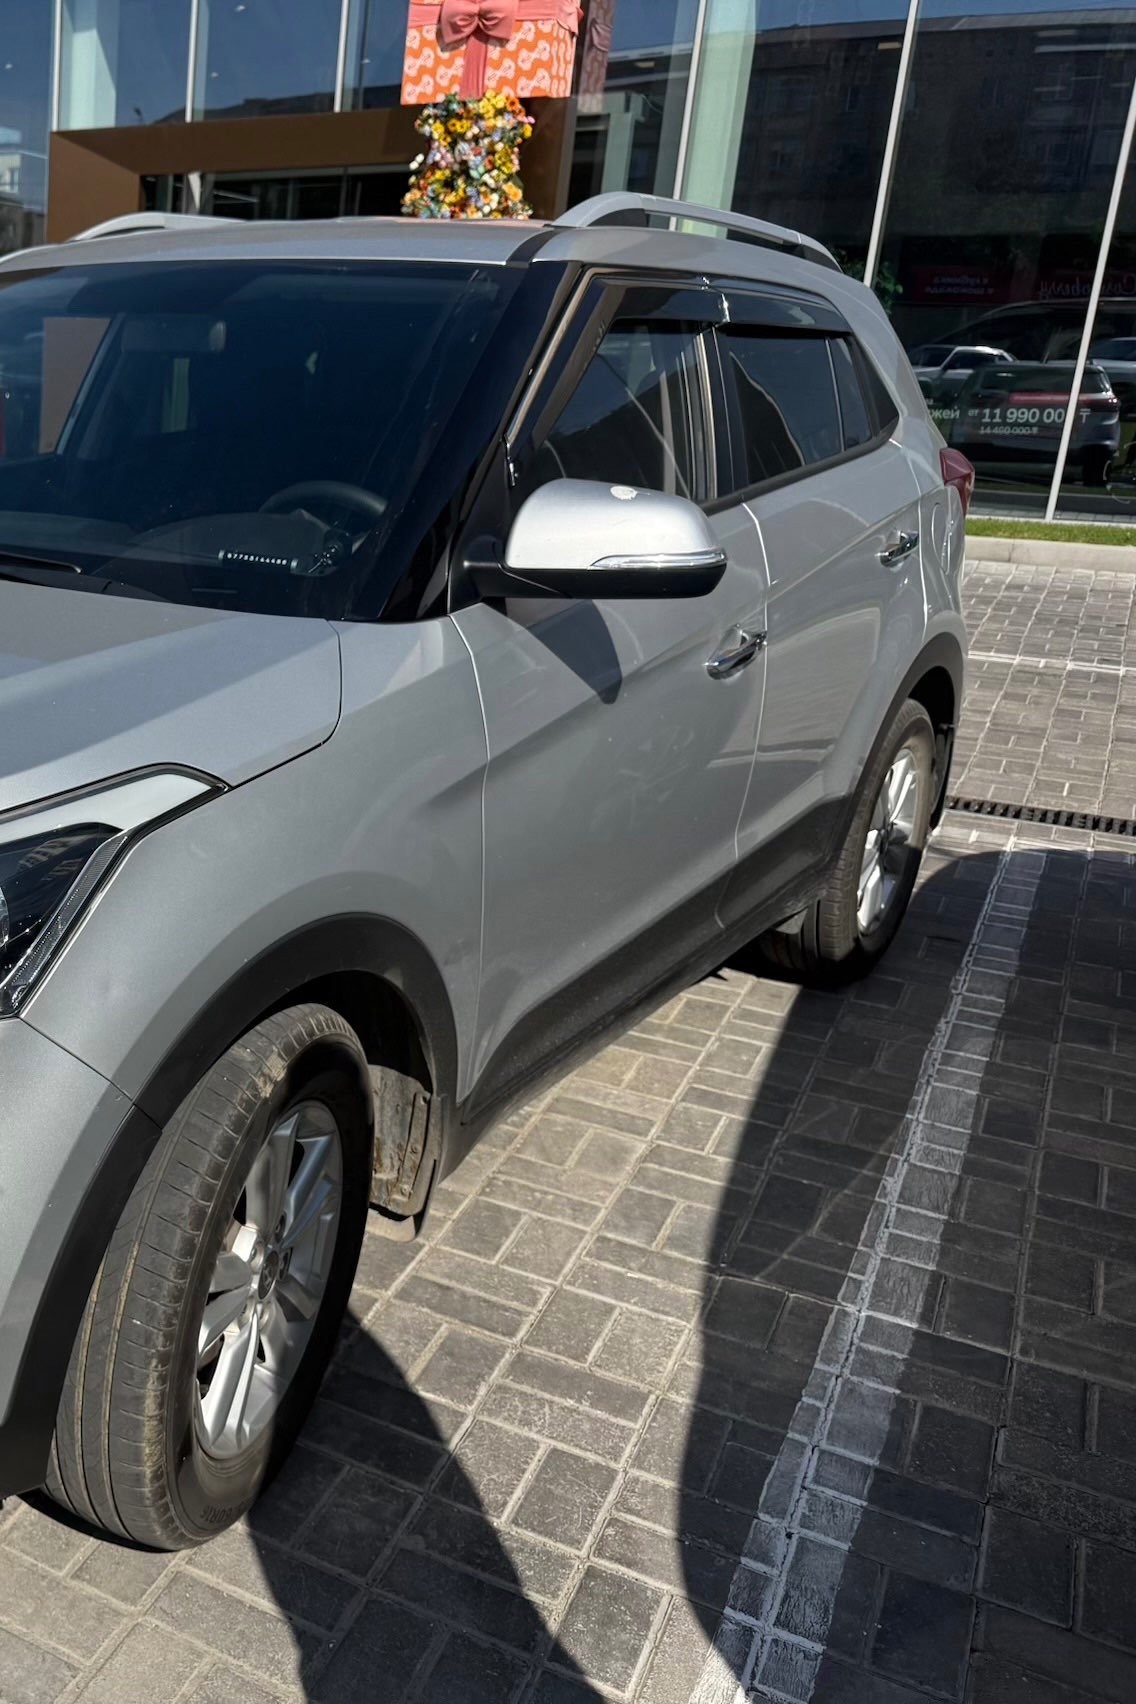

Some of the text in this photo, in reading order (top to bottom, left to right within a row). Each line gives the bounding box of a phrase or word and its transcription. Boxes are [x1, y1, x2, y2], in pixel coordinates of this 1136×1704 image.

[928, 405, 960, 419] жей
[981, 407, 1002, 422] 11
[1006, 407, 1040, 423] 990
